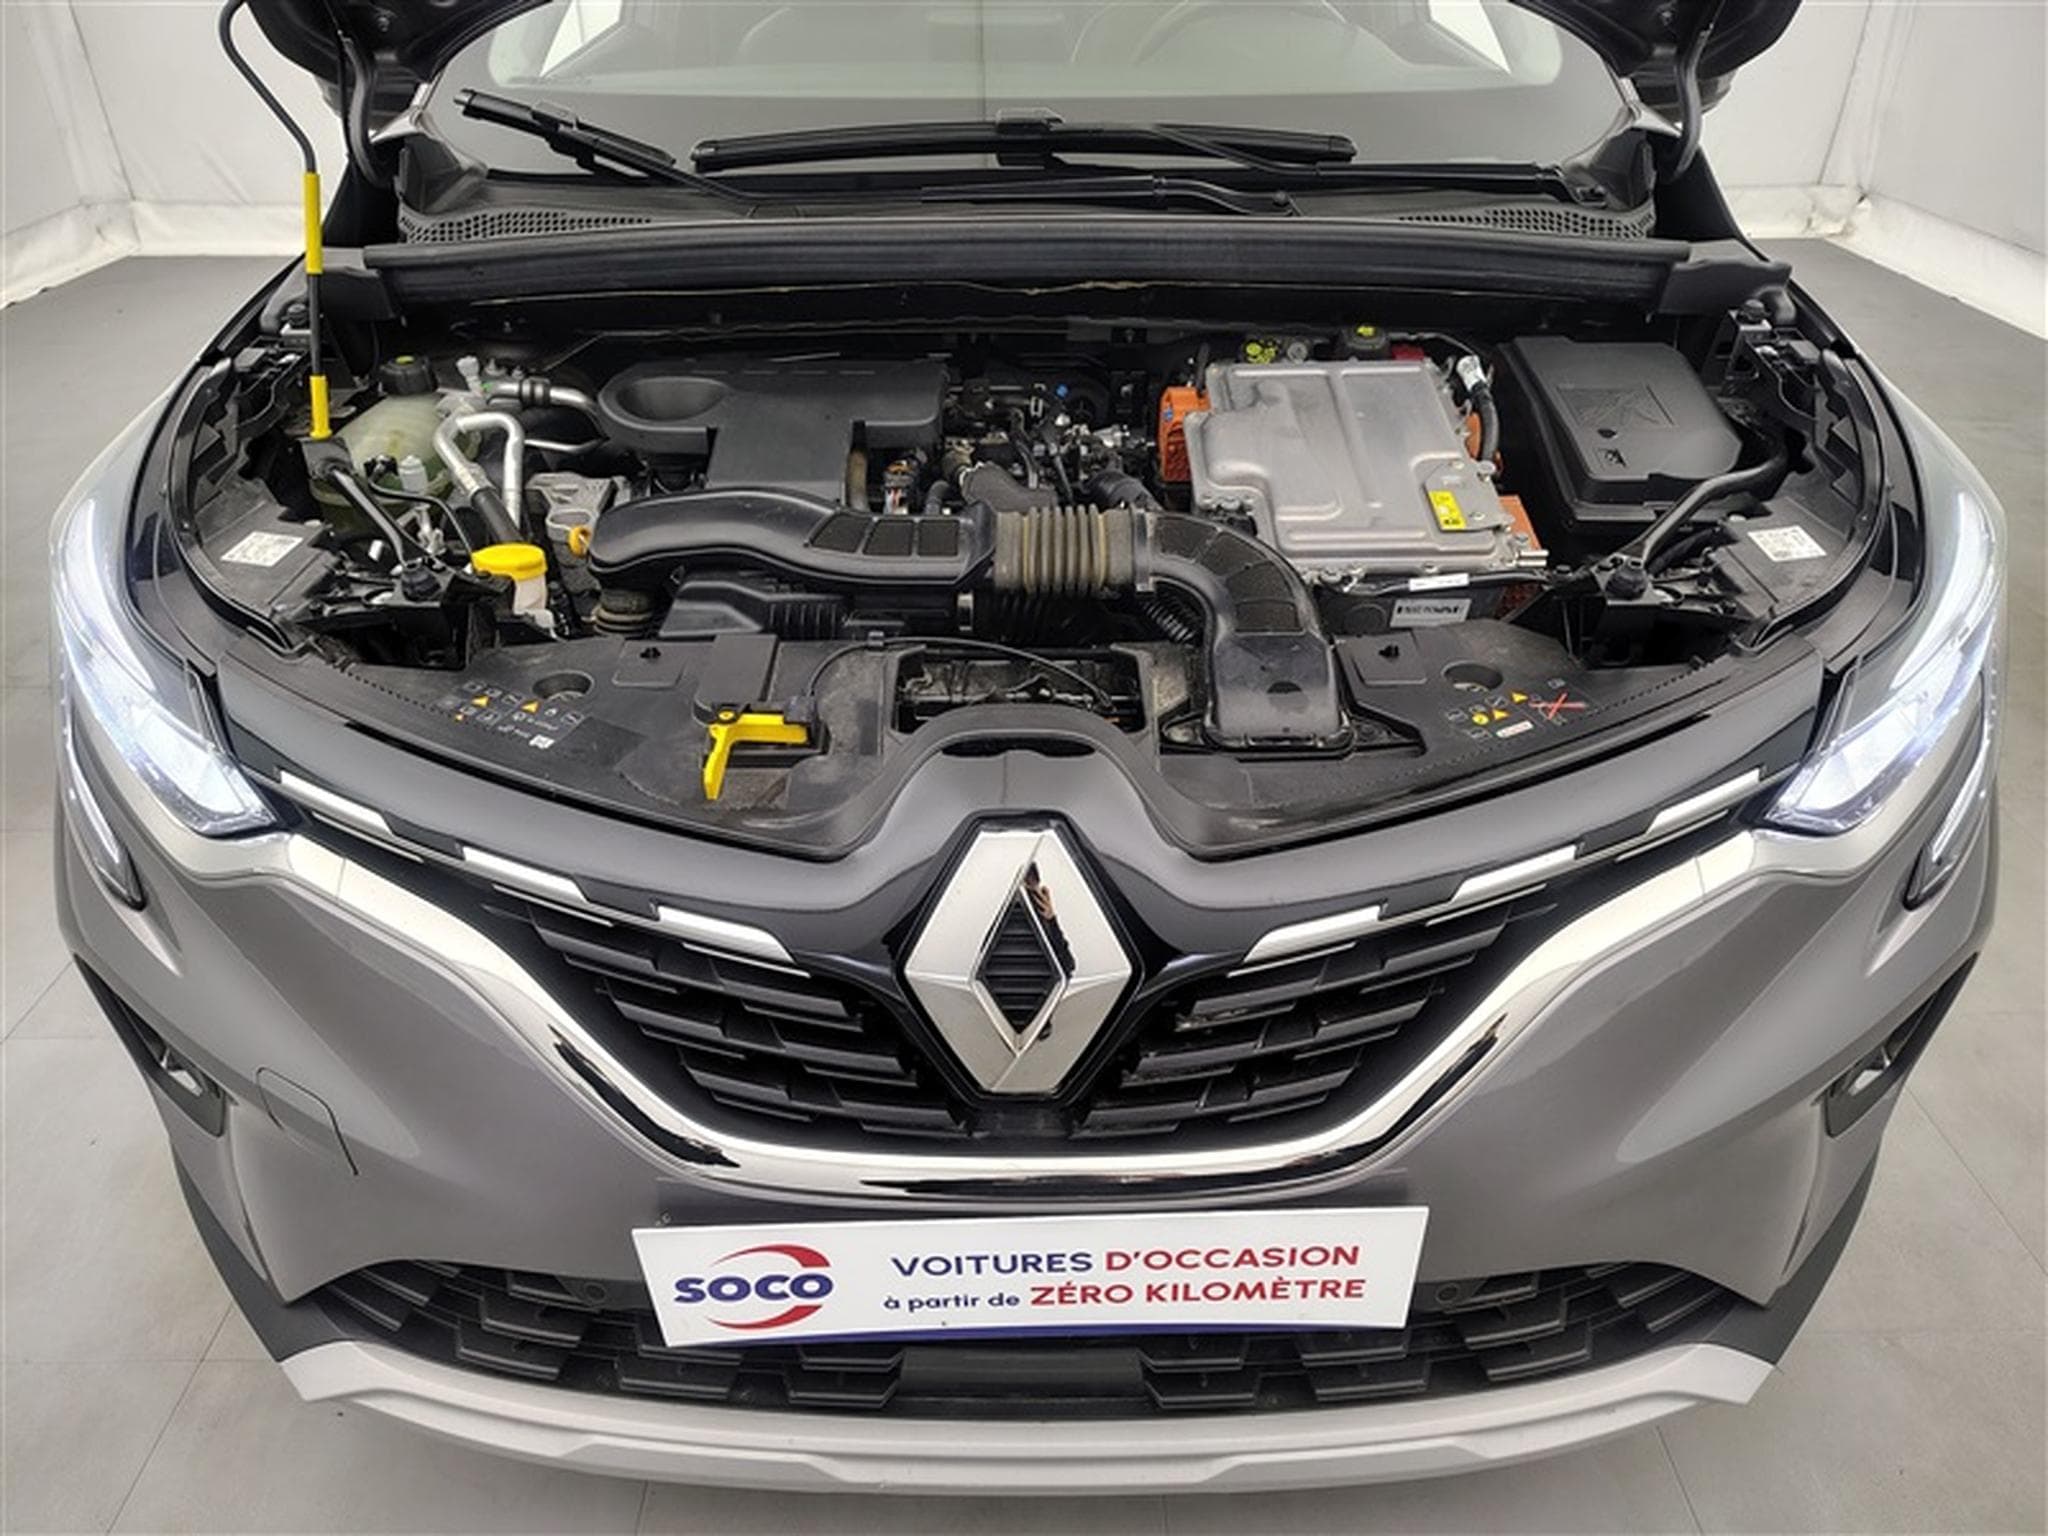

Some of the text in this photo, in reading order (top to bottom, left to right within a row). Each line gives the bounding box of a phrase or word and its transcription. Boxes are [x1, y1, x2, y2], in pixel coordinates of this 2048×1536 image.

[891, 1246, 1359, 1276] VOITURES D'OCCASION
[674, 1273, 833, 1303] SOCO
[884, 1276, 1366, 1313] à partir de ZÉRO KILOMÈTRE
